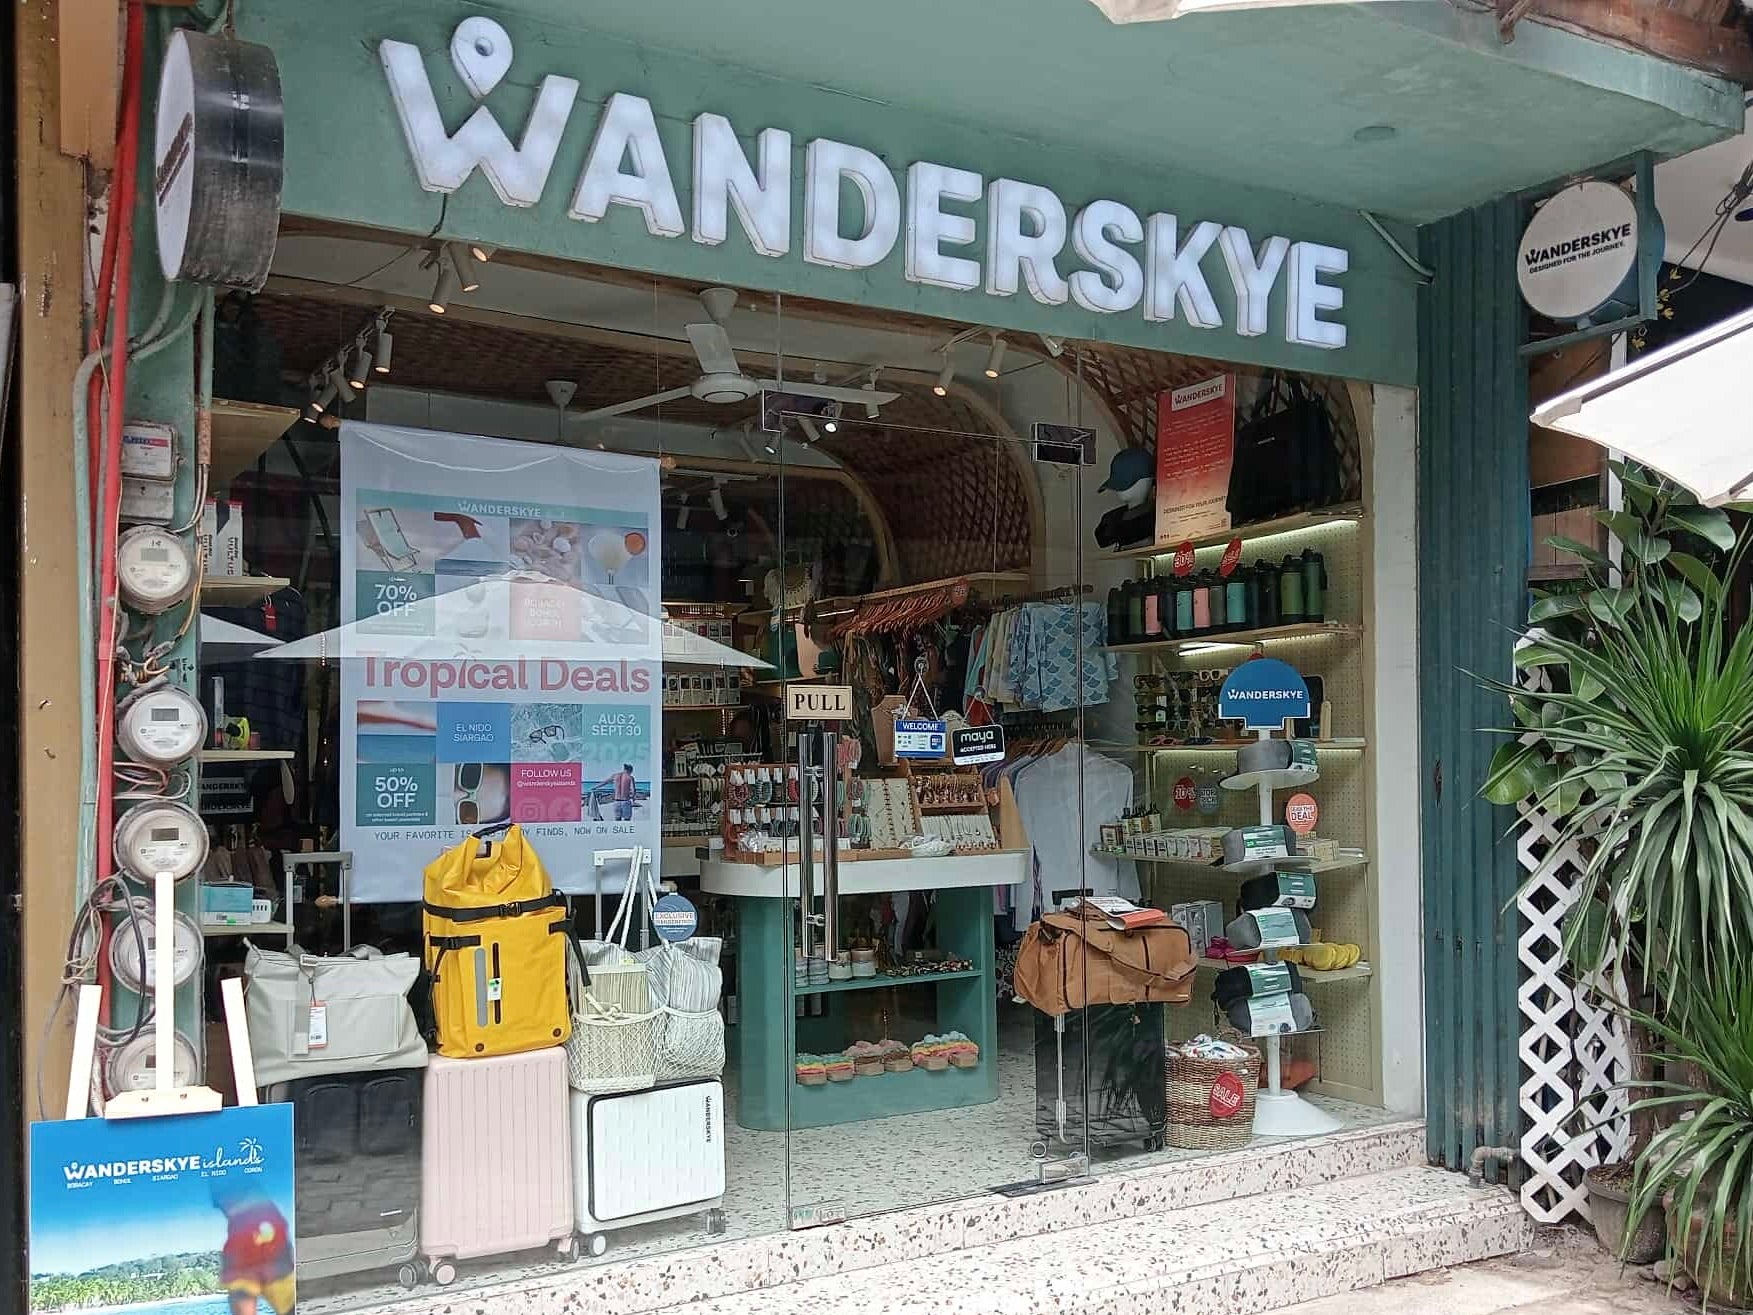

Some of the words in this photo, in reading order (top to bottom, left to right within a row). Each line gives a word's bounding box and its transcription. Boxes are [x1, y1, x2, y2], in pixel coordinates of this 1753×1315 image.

[379, 16, 1349, 350] WANDERSKYE
[1525, 223, 1632, 267] WANDERSKYE
[1529, 259, 1562, 274] DESIGNED
[1563, 255, 1576, 265] FOR
[1578, 251, 1591, 262] THE
[1174, 382, 1223, 406] WANDERSKYE
[458, 499, 541, 517] WANDERSKYE
[374, 584, 417, 600] 70%
[377, 601, 416, 616] OFF
[357, 651, 528, 699] Tropical
[540, 655, 650, 692] Deals
[1227, 688, 1303, 700] WANDERSKYE
[794, 693, 845, 711] PULL
[599, 713, 625, 725] AUG
[628, 714, 636, 725] 2
[902, 722, 939, 731] WELCOME
[456, 723, 467, 732] EL
[469, 723, 492, 732] NIDO
[591, 725, 625, 736] SEPT
[626, 726, 641, 736] 30
[960, 730, 994, 743] maya
[521, 769, 560, 778] FOLLOW
[560, 768, 572, 777] US
[375, 776, 418, 791] 50%
[377, 792, 416, 808] OFF
[1291, 811, 1313, 821] DEAL
[374, 831, 400, 841] YOUR
[406, 830, 455, 840] FAVORITE
[536, 827, 568, 837] FINDS,
[574, 827, 592, 836] NOW
[596, 826, 608, 835] ON
[612, 825, 636, 834] SALE
[1212, 1083, 1241, 1107] SALE
[704, 1095, 712, 1143] WANDERSKYE
[63, 1155, 200, 1181] WANDERSKYE
